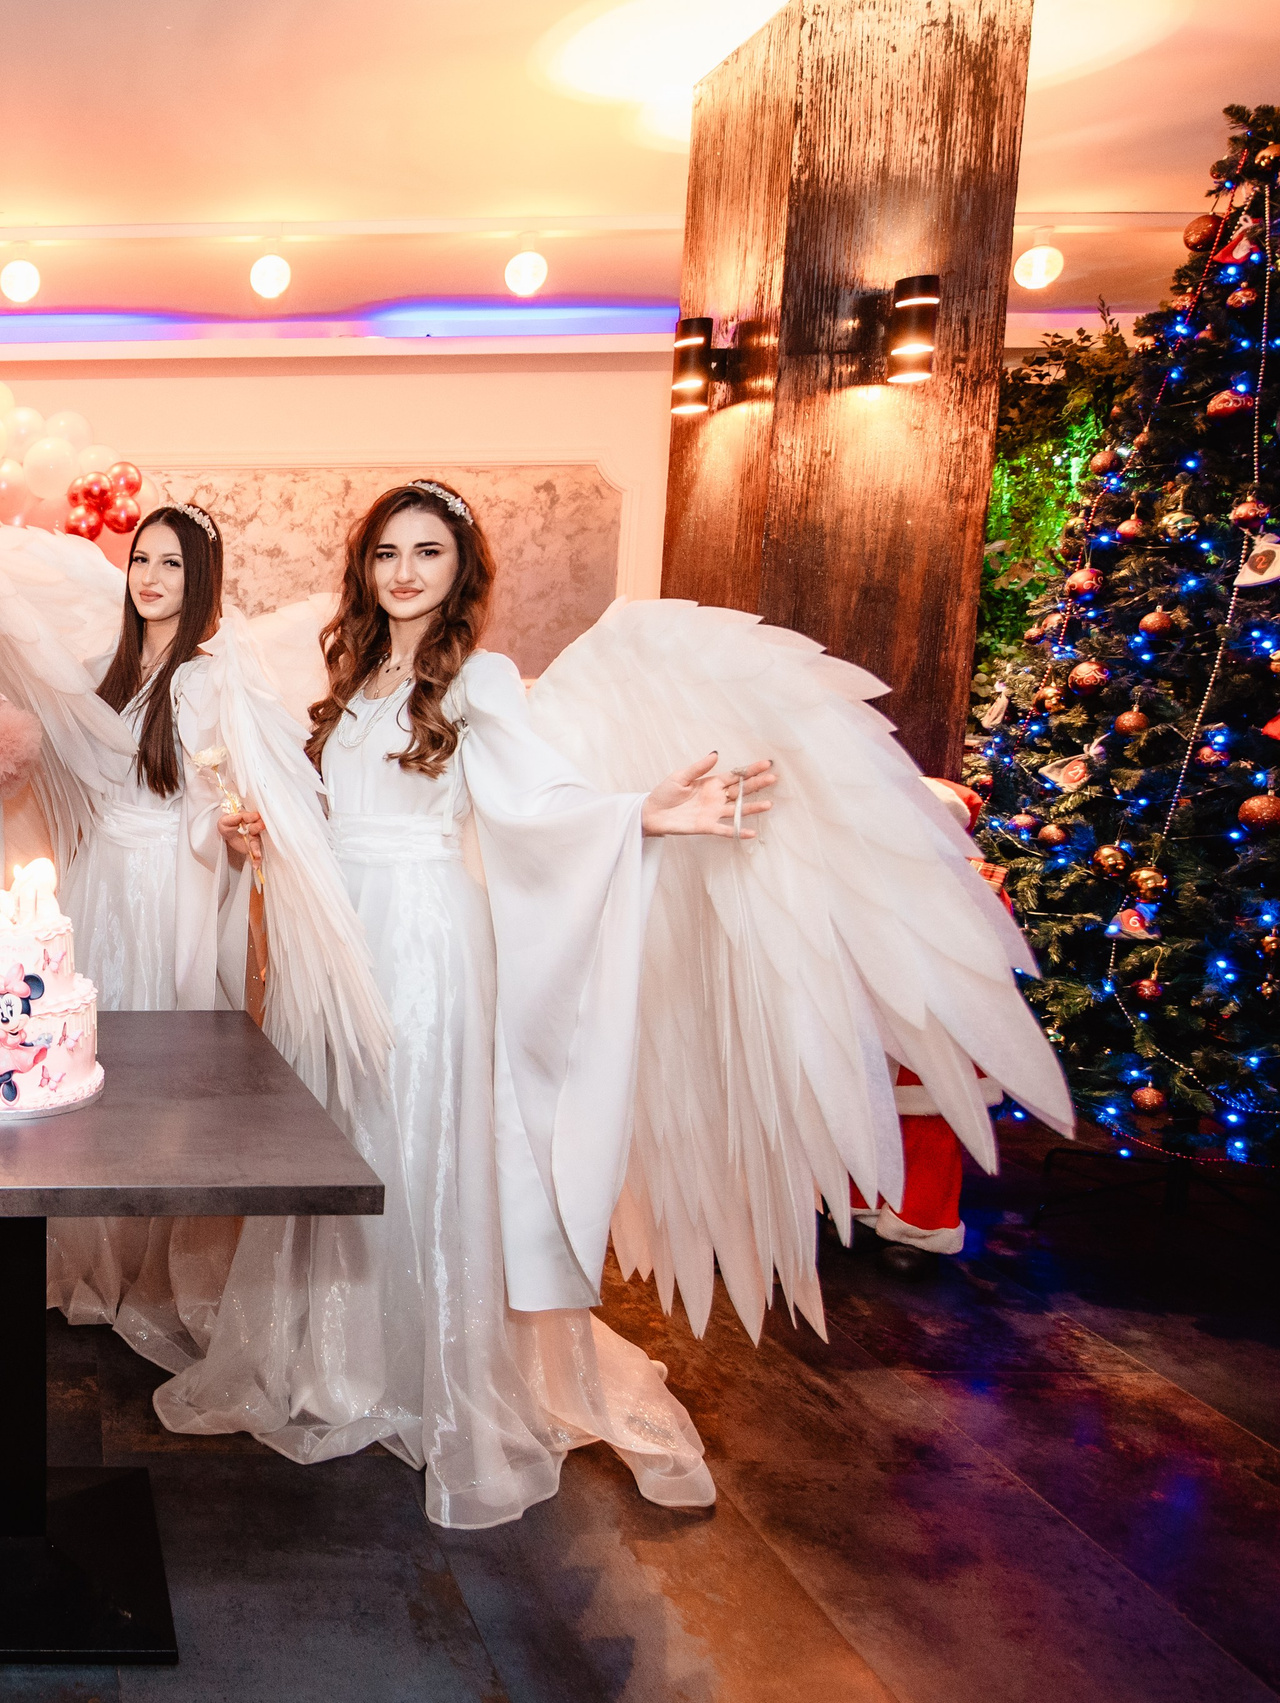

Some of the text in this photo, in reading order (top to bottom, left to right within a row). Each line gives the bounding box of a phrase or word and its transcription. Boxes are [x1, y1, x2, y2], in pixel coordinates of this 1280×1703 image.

[1255, 555, 1268, 569] 2
[1067, 765, 1084, 779] 21
[1129, 915, 1141, 927] 6
